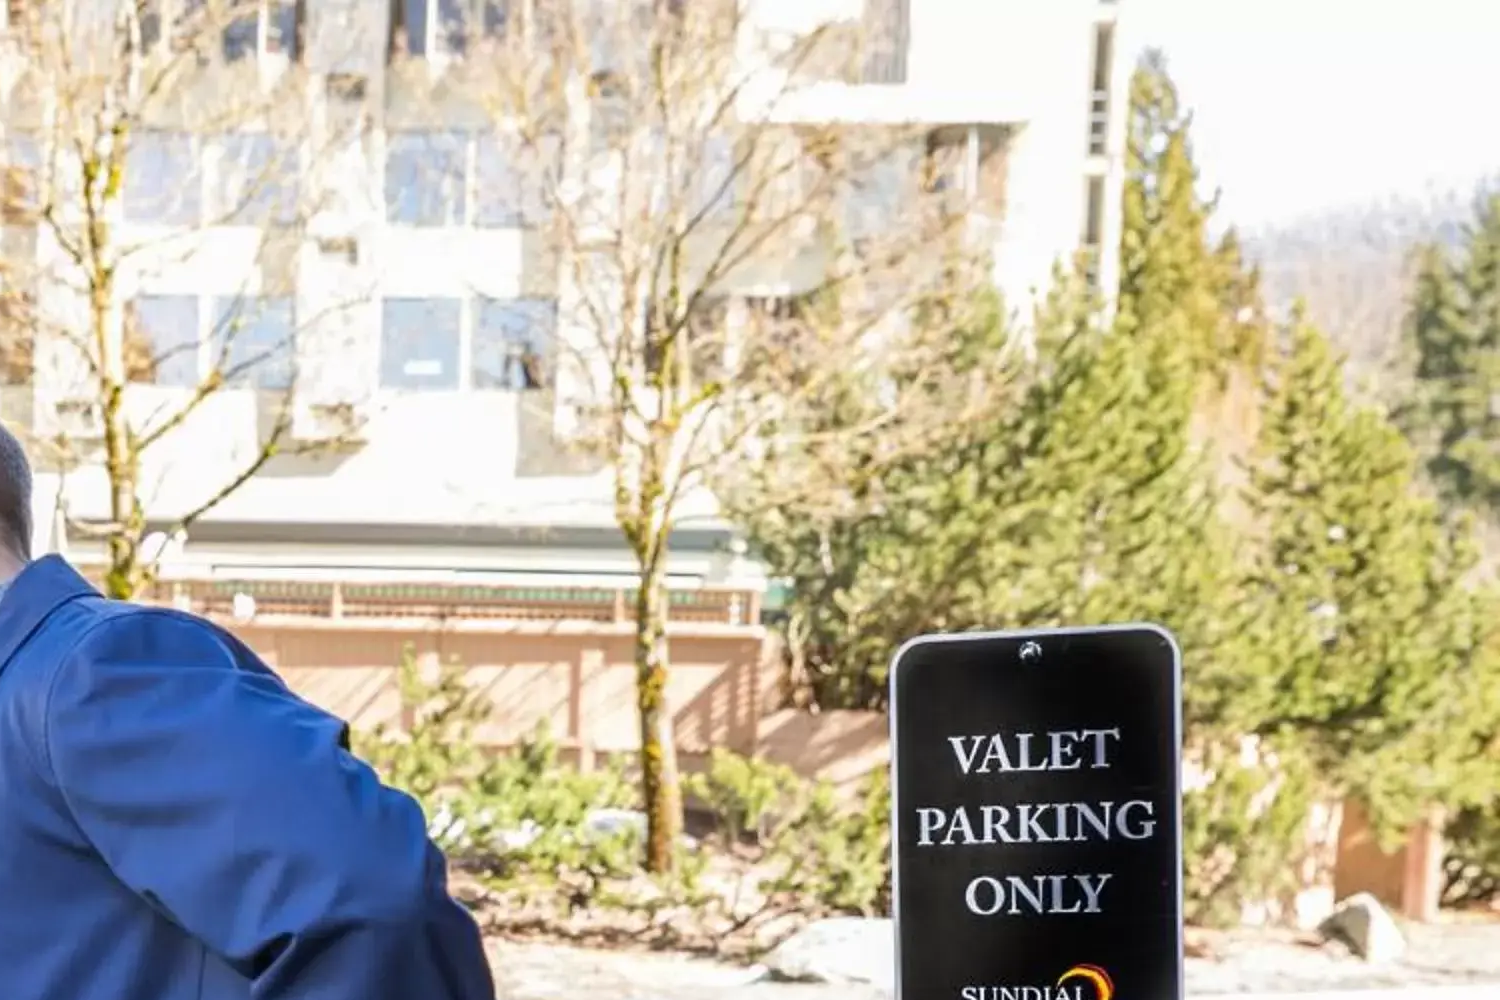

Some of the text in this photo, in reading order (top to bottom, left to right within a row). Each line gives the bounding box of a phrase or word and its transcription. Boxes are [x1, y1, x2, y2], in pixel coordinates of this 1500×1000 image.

[947, 728, 1121, 774] VALET
[915, 800, 1158, 847] PARKING
[965, 873, 1113, 916] ONLY
